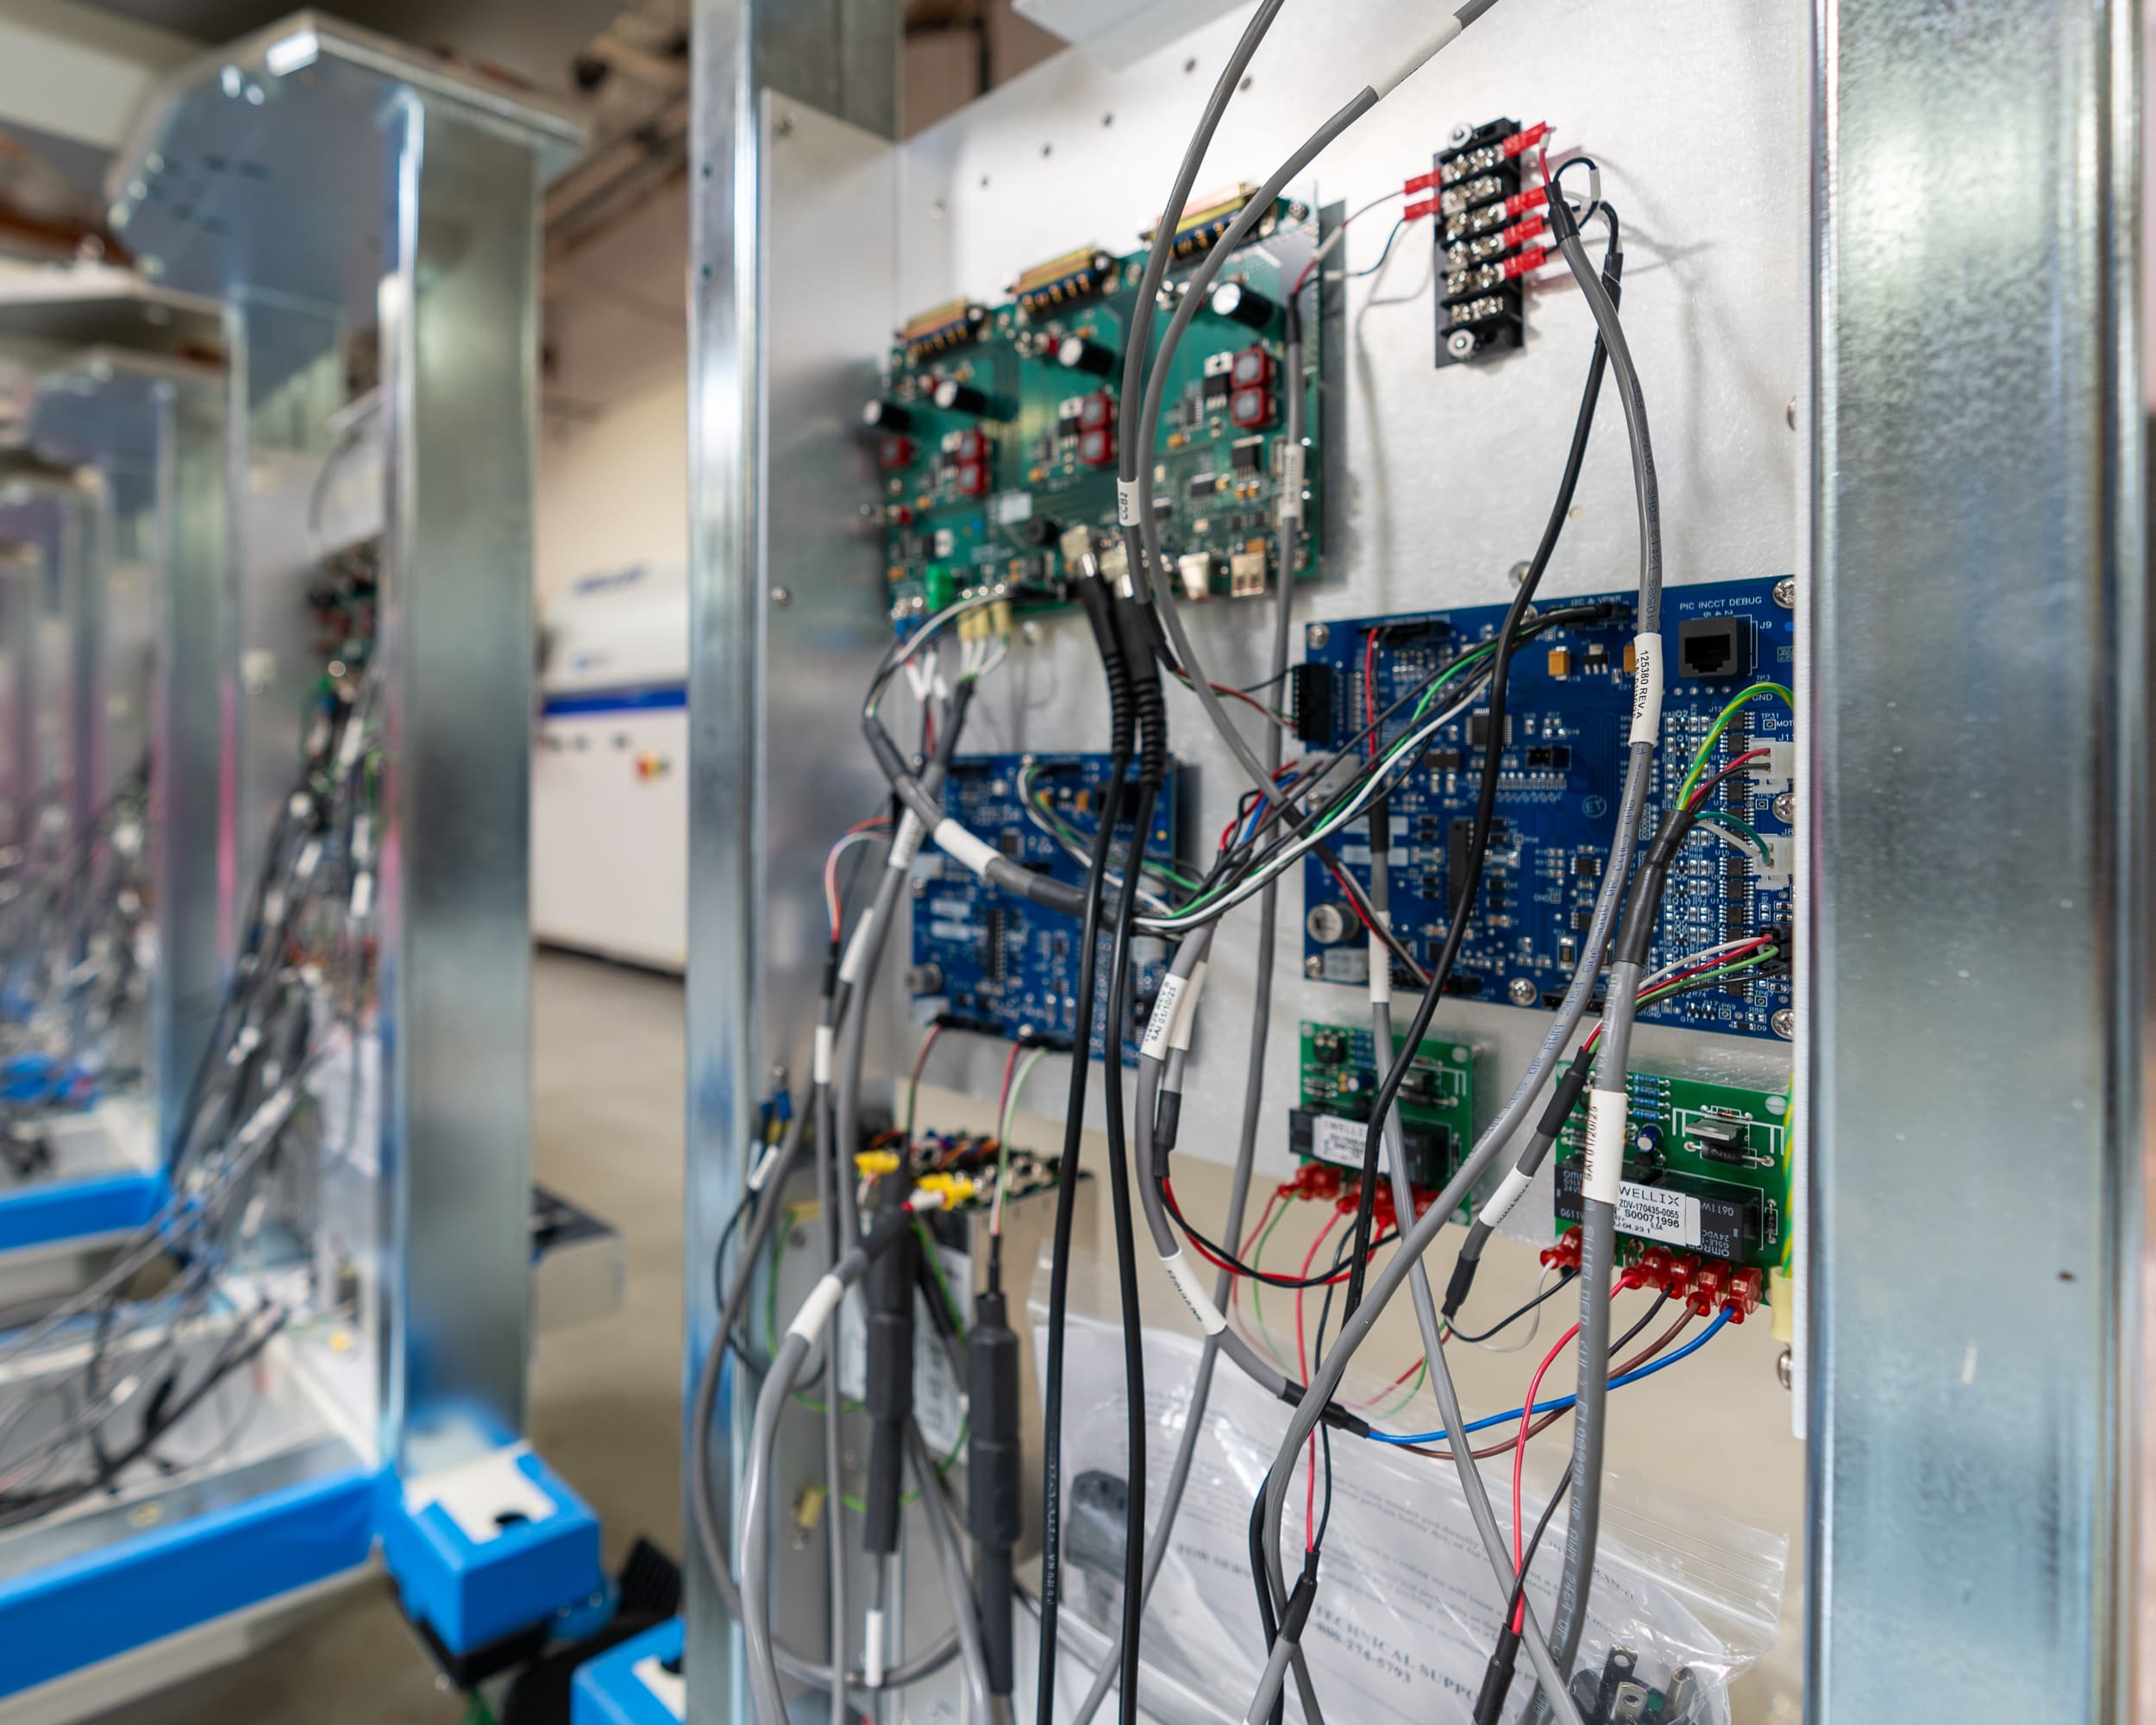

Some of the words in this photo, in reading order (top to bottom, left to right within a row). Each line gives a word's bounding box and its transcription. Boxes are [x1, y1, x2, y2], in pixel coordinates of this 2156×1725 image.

[1679, 602, 1695, 611] PIC
[1729, 596, 1763, 607] DEBUG
[1759, 620, 1772, 630] J9
[1639, 649, 1650, 685] 125380
[1752, 693, 1773, 702] GND
[1619, 1185, 1680, 1207] WELLIX
[1619, 1198, 1680, 1220] ZDV-170435-0055
[1624, 1209, 1681, 1228] S00071996
